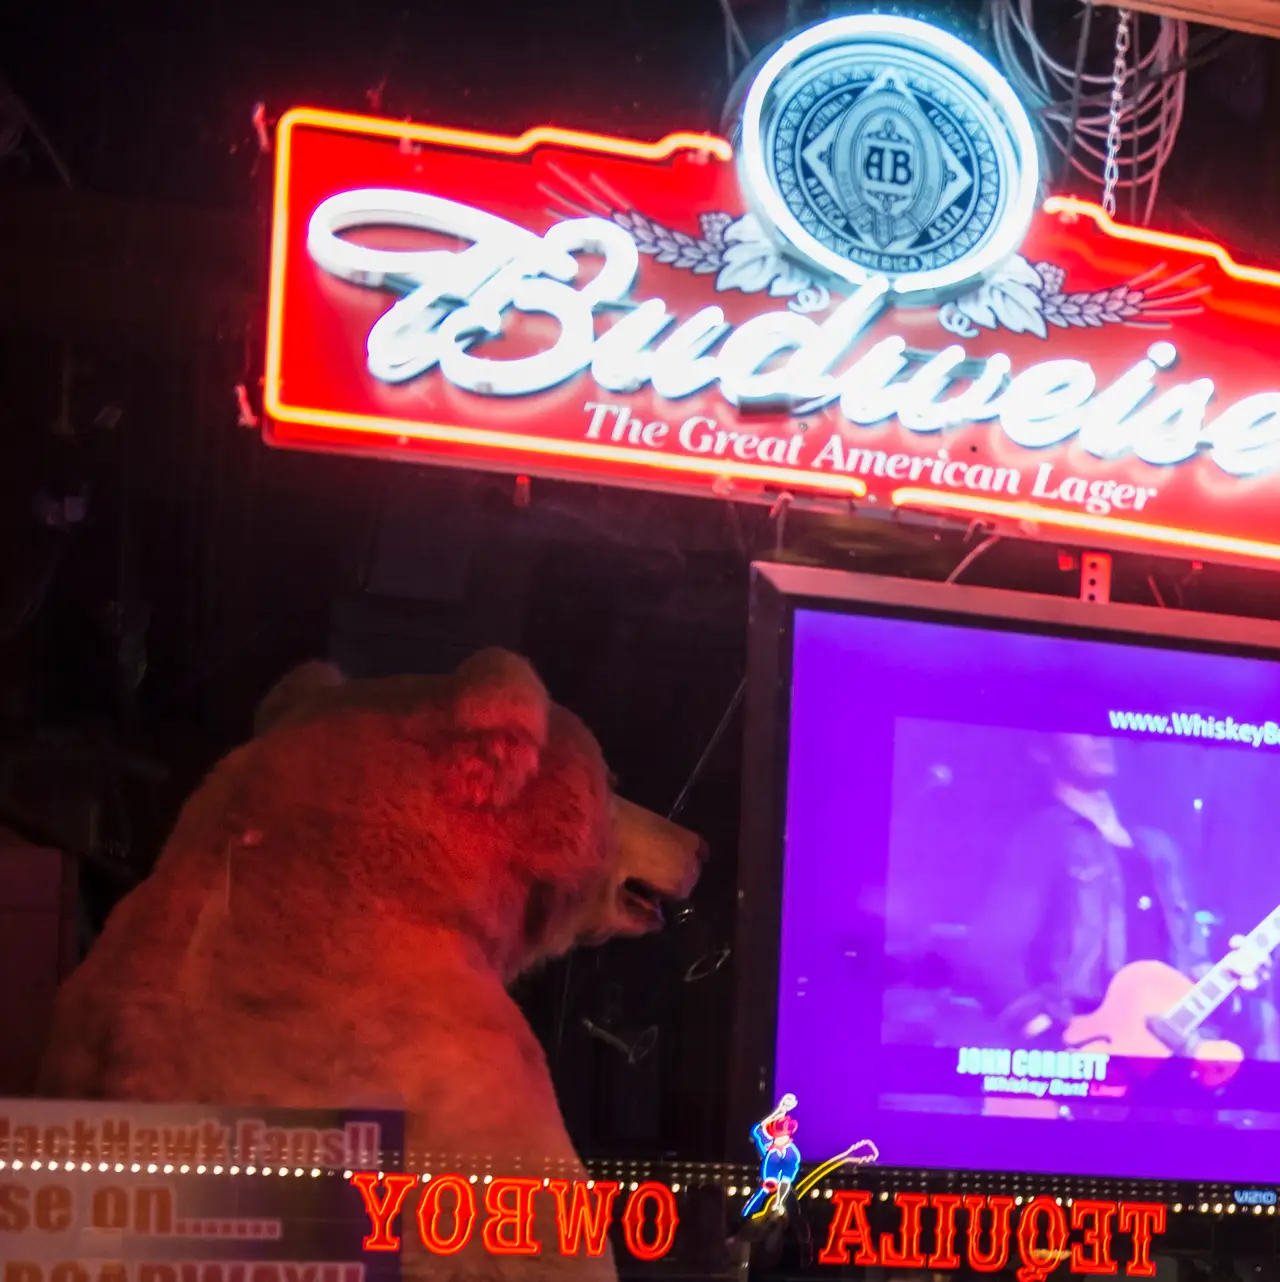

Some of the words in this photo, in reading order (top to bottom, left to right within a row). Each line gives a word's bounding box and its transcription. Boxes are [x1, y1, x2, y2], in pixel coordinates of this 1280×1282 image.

[583, 401, 665, 447] The
[679, 419, 804, 465] Great
[815, 433, 1019, 494] American
[1032, 462, 1157, 516] Lager
